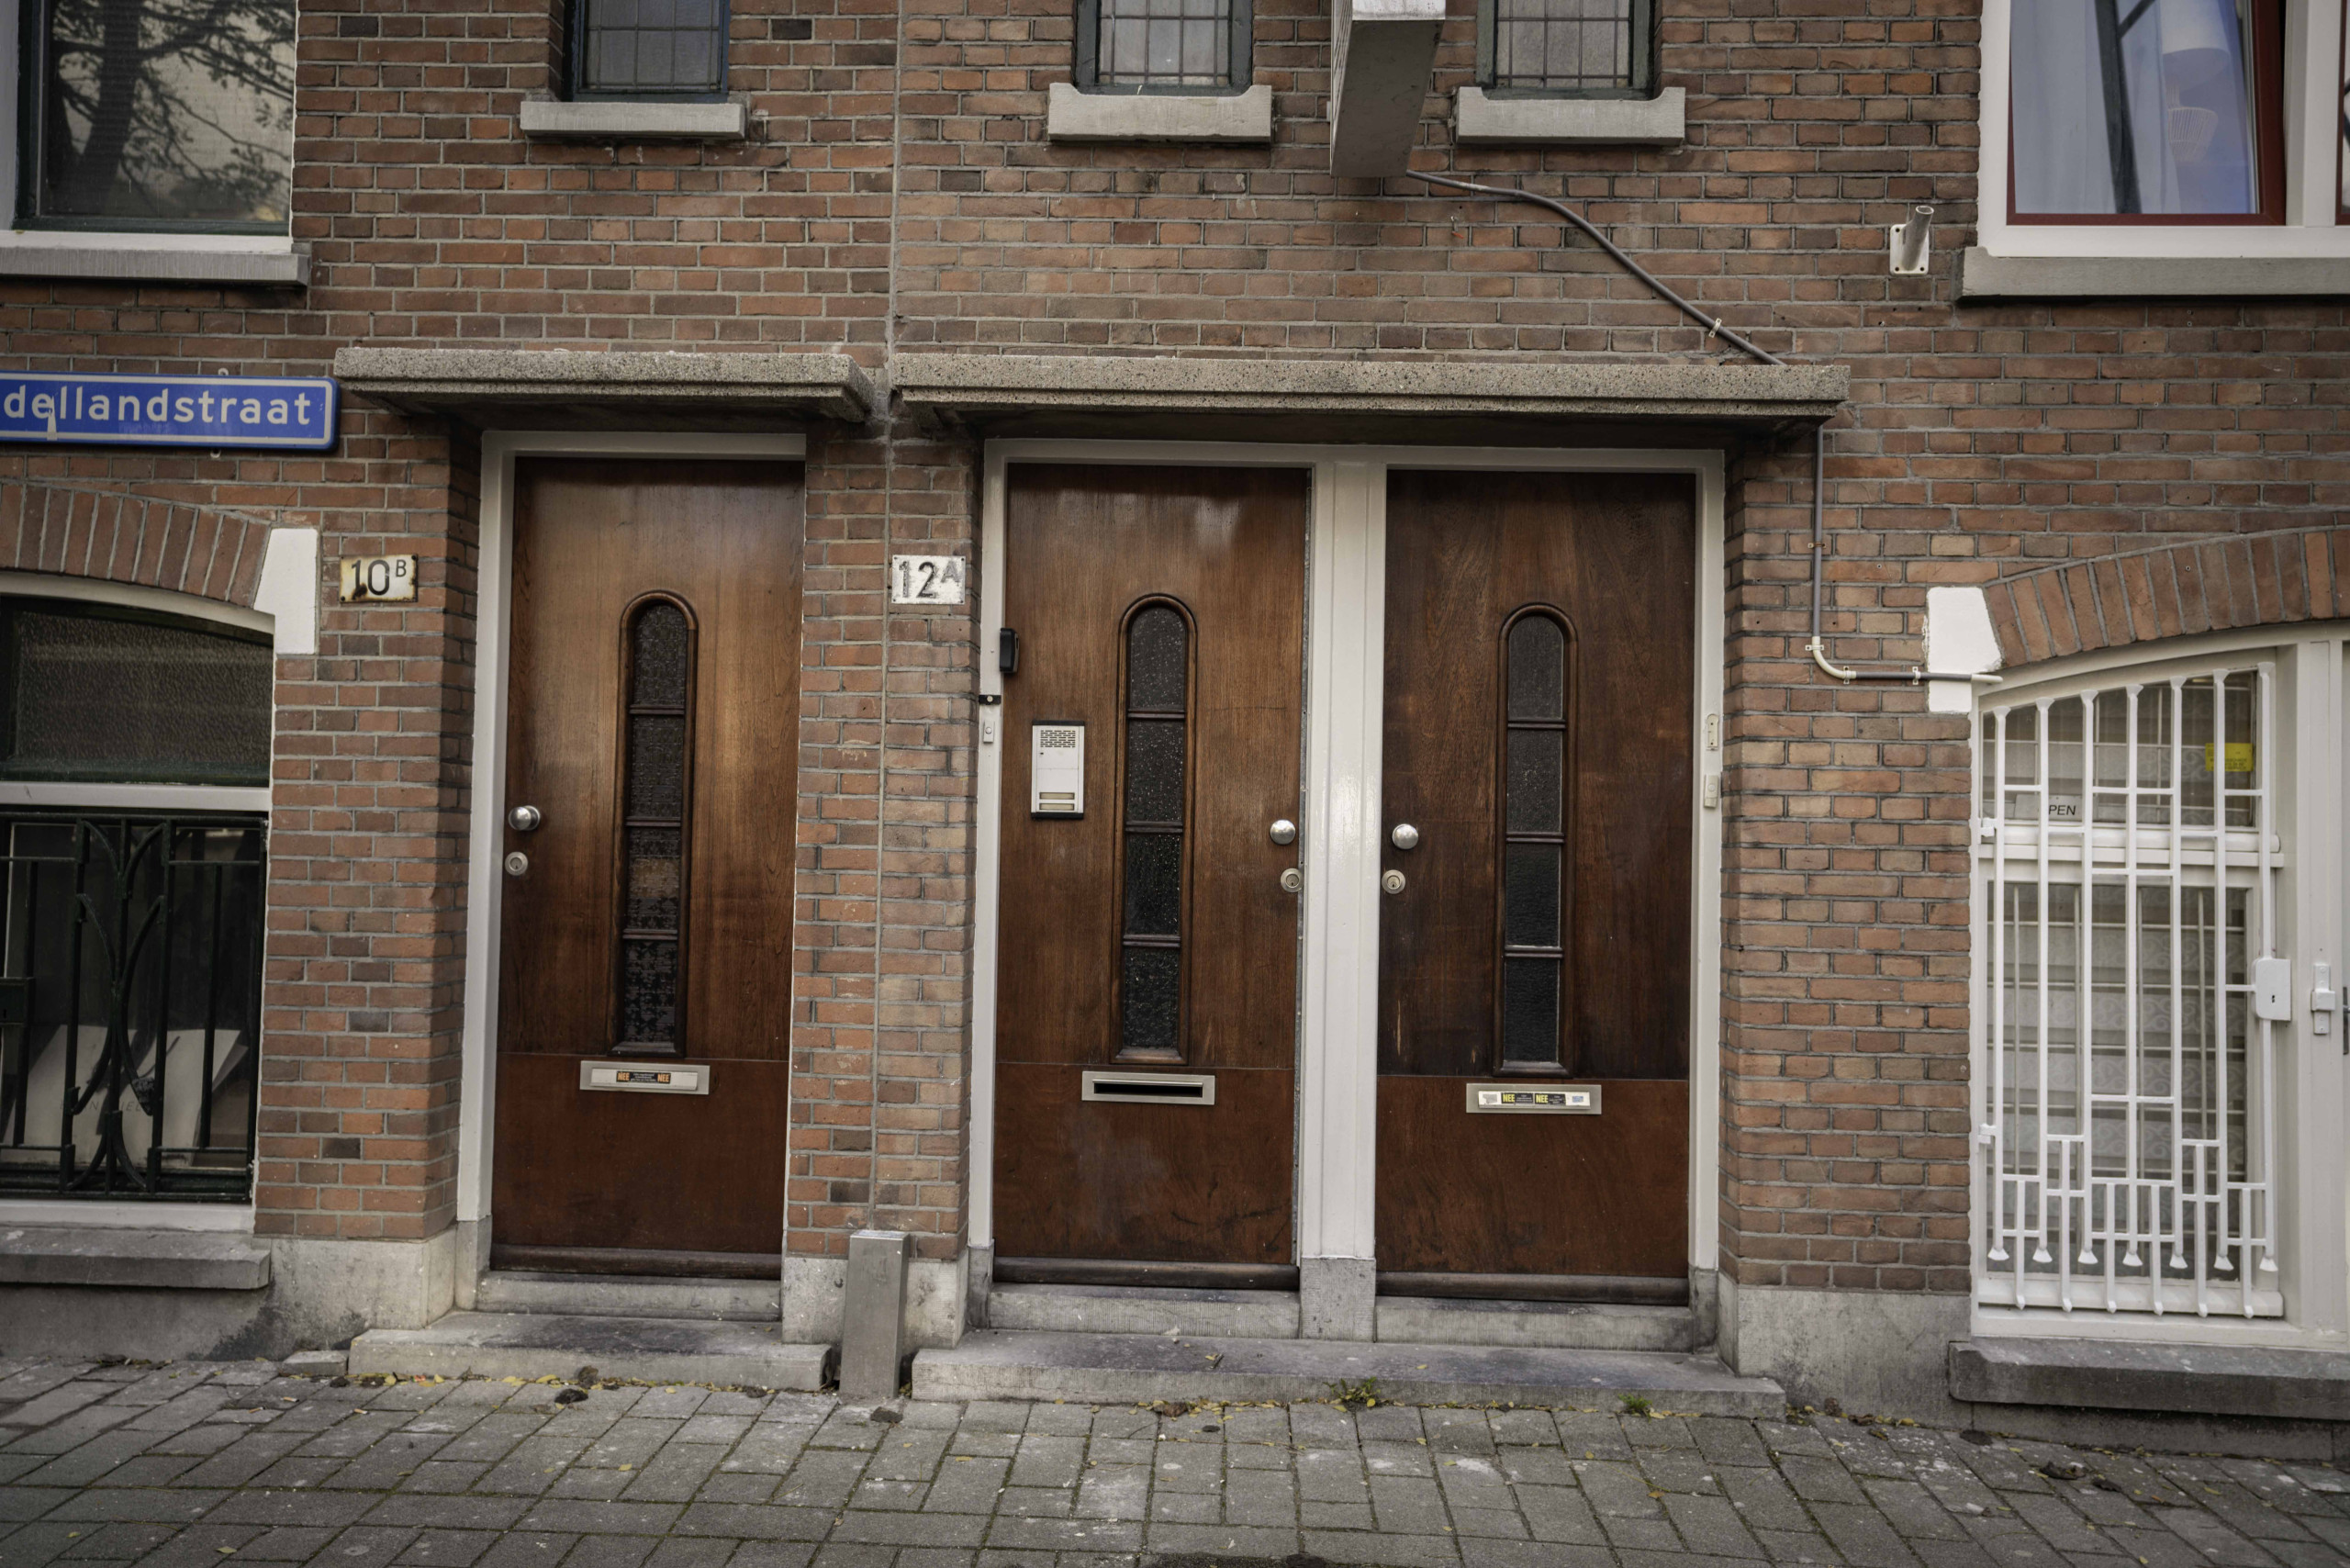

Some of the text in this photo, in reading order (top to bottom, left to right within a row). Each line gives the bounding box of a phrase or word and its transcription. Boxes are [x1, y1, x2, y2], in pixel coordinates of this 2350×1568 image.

[2039, 804, 2076, 816] PEN
[617, 1071, 630, 1081] NEE
[657, 1073, 669, 1082] NEE
[1503, 1093, 1515, 1103] NEE
[1536, 1094, 1549, 1103] NEE
